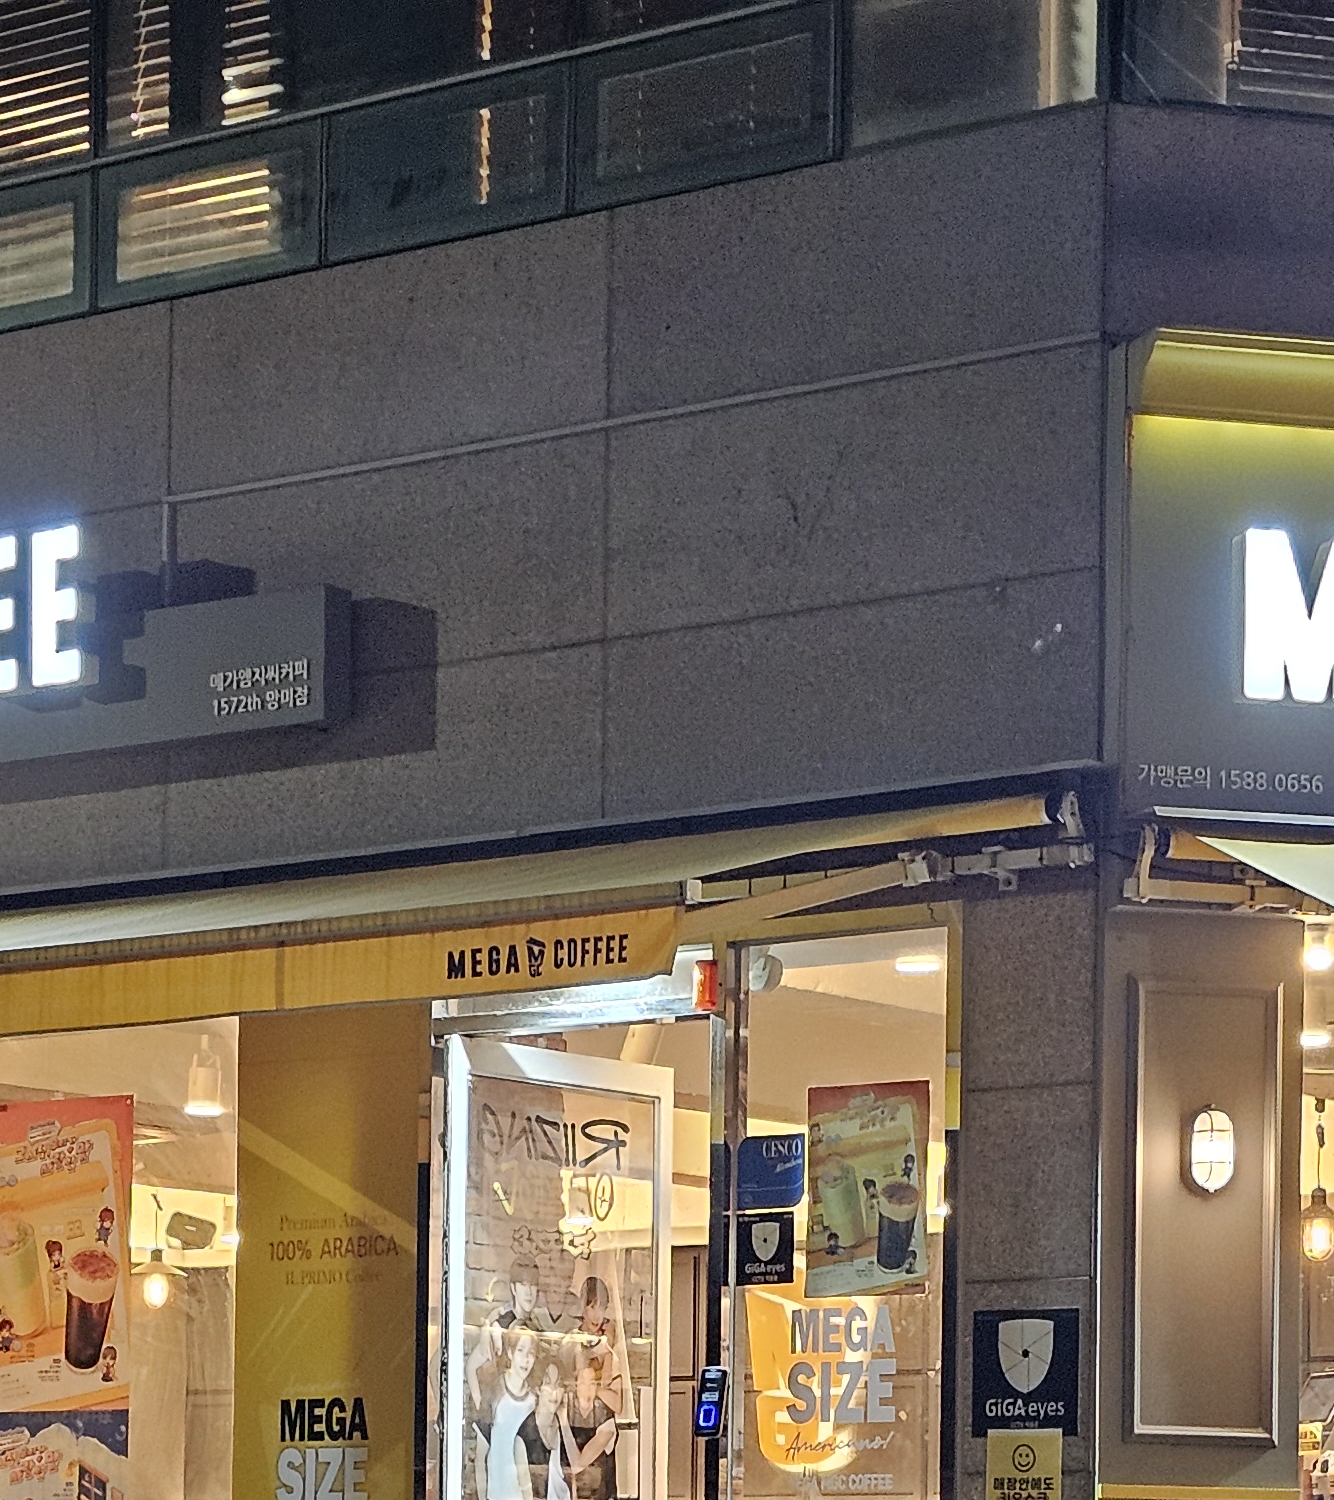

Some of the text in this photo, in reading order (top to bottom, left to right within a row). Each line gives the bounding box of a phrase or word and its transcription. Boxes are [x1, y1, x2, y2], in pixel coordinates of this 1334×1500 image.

[210, 657, 307, 691] 메가엠지씨커피
[212, 685, 308, 717] 1572th 망미점
[1138, 764, 1324, 794] 가맹문의 1588.0656
[447, 934, 629, 980] MEGA COFFEE
[762, 1137, 802, 1158] CESCO
[269, 1234, 399, 1261] 100% ARABICA
[790, 1304, 896, 1355] MEGA
[786, 1358, 897, 1424] SIZE
[280, 1396, 369, 1443] MEGA
[986, 1399, 1065, 1421] GiGA eyes
[848, 1472, 893, 1492] COFFEE
[993, 1477, 1054, 1491] 매장안에도
